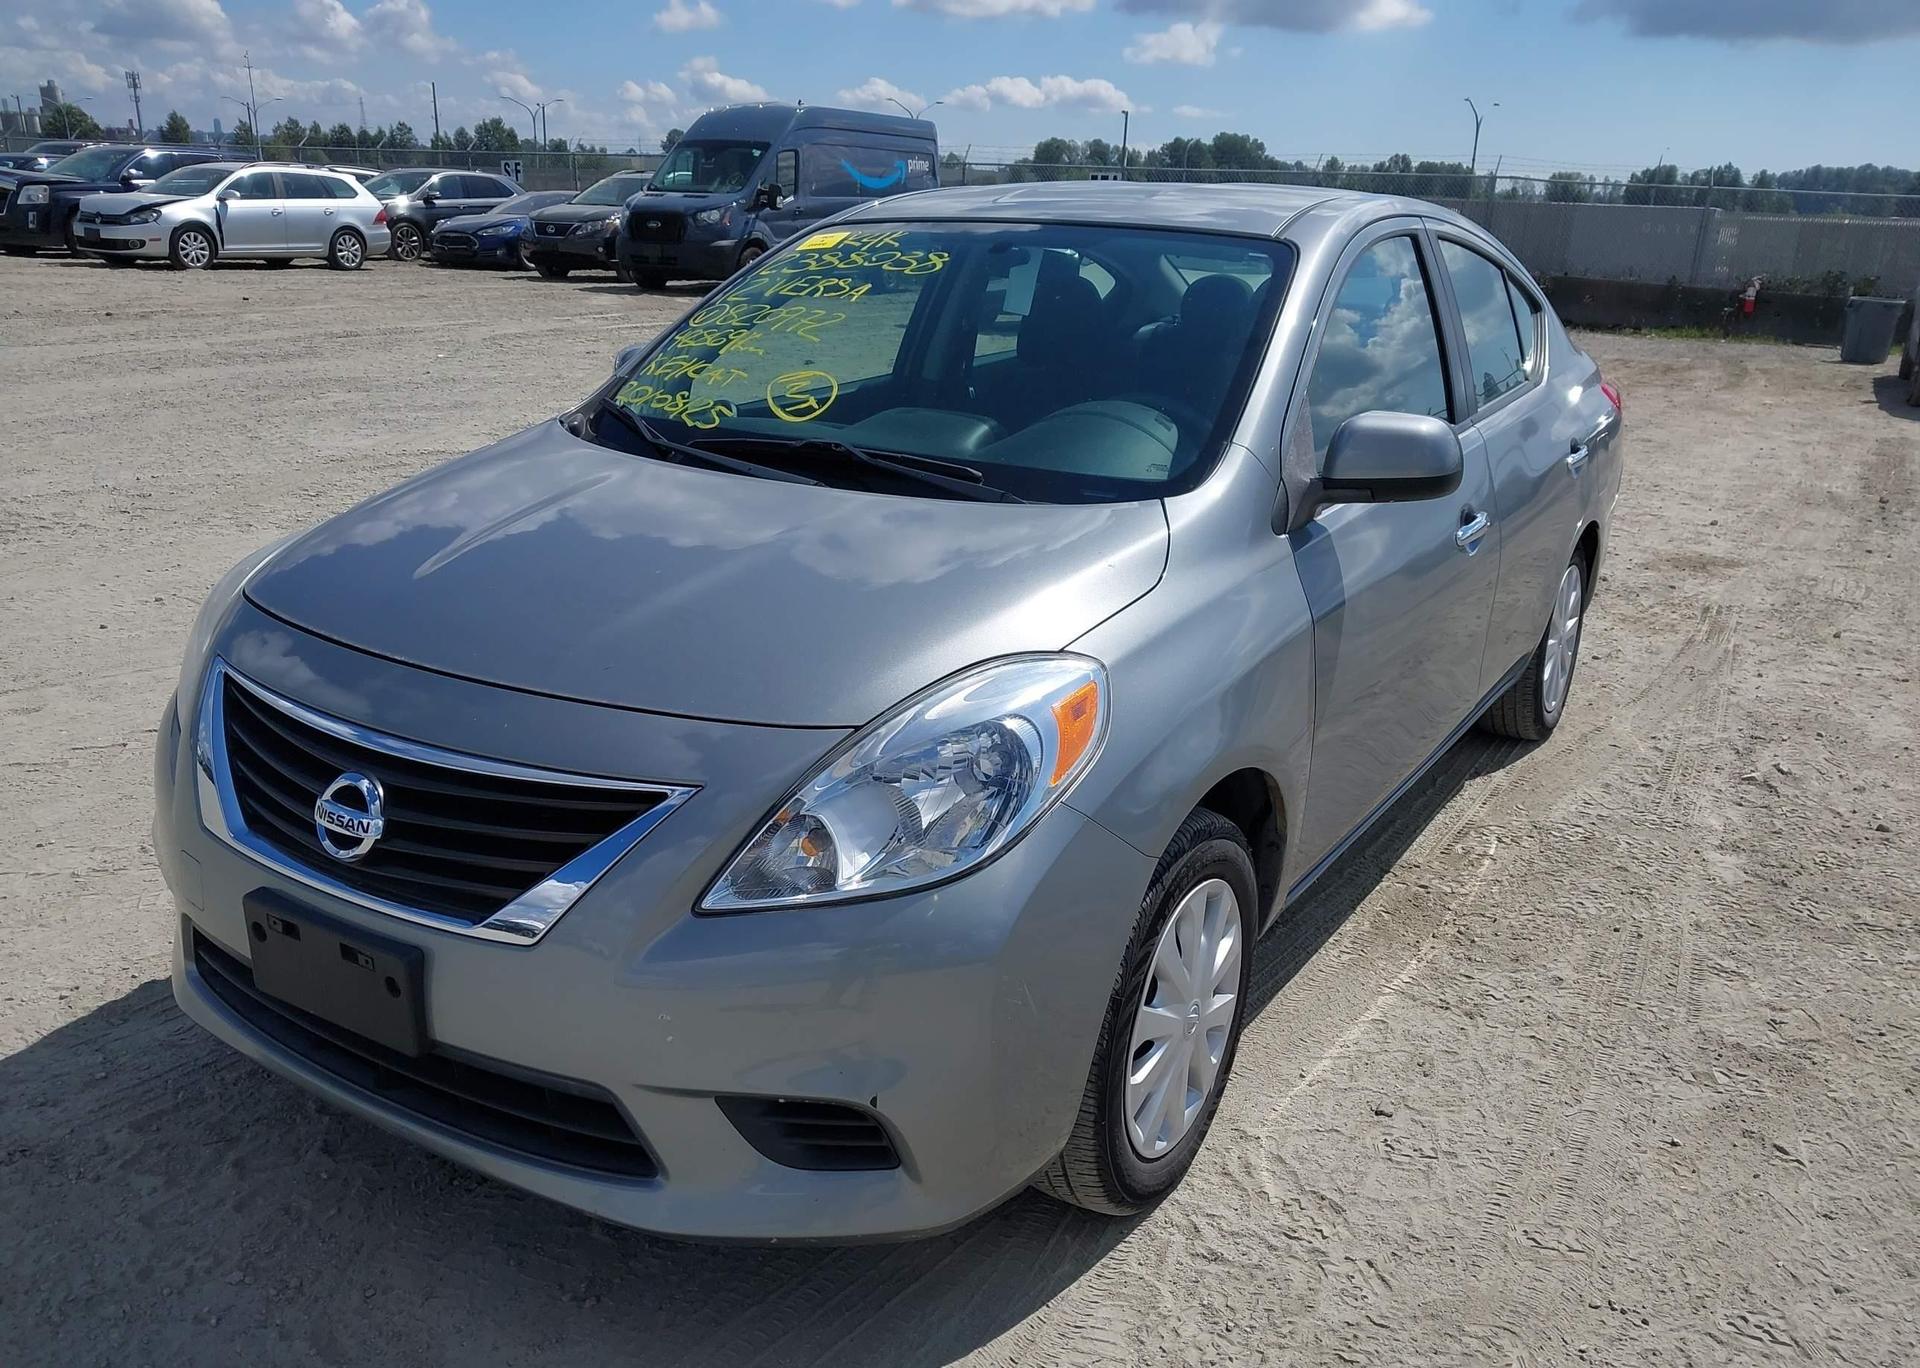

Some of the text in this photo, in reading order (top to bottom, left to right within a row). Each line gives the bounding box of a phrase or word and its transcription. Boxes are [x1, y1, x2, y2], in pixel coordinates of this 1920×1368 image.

[907, 155, 930, 173] prime
[765, 276, 873, 302] VERSA
[316, 802, 371, 834] NISSAN
